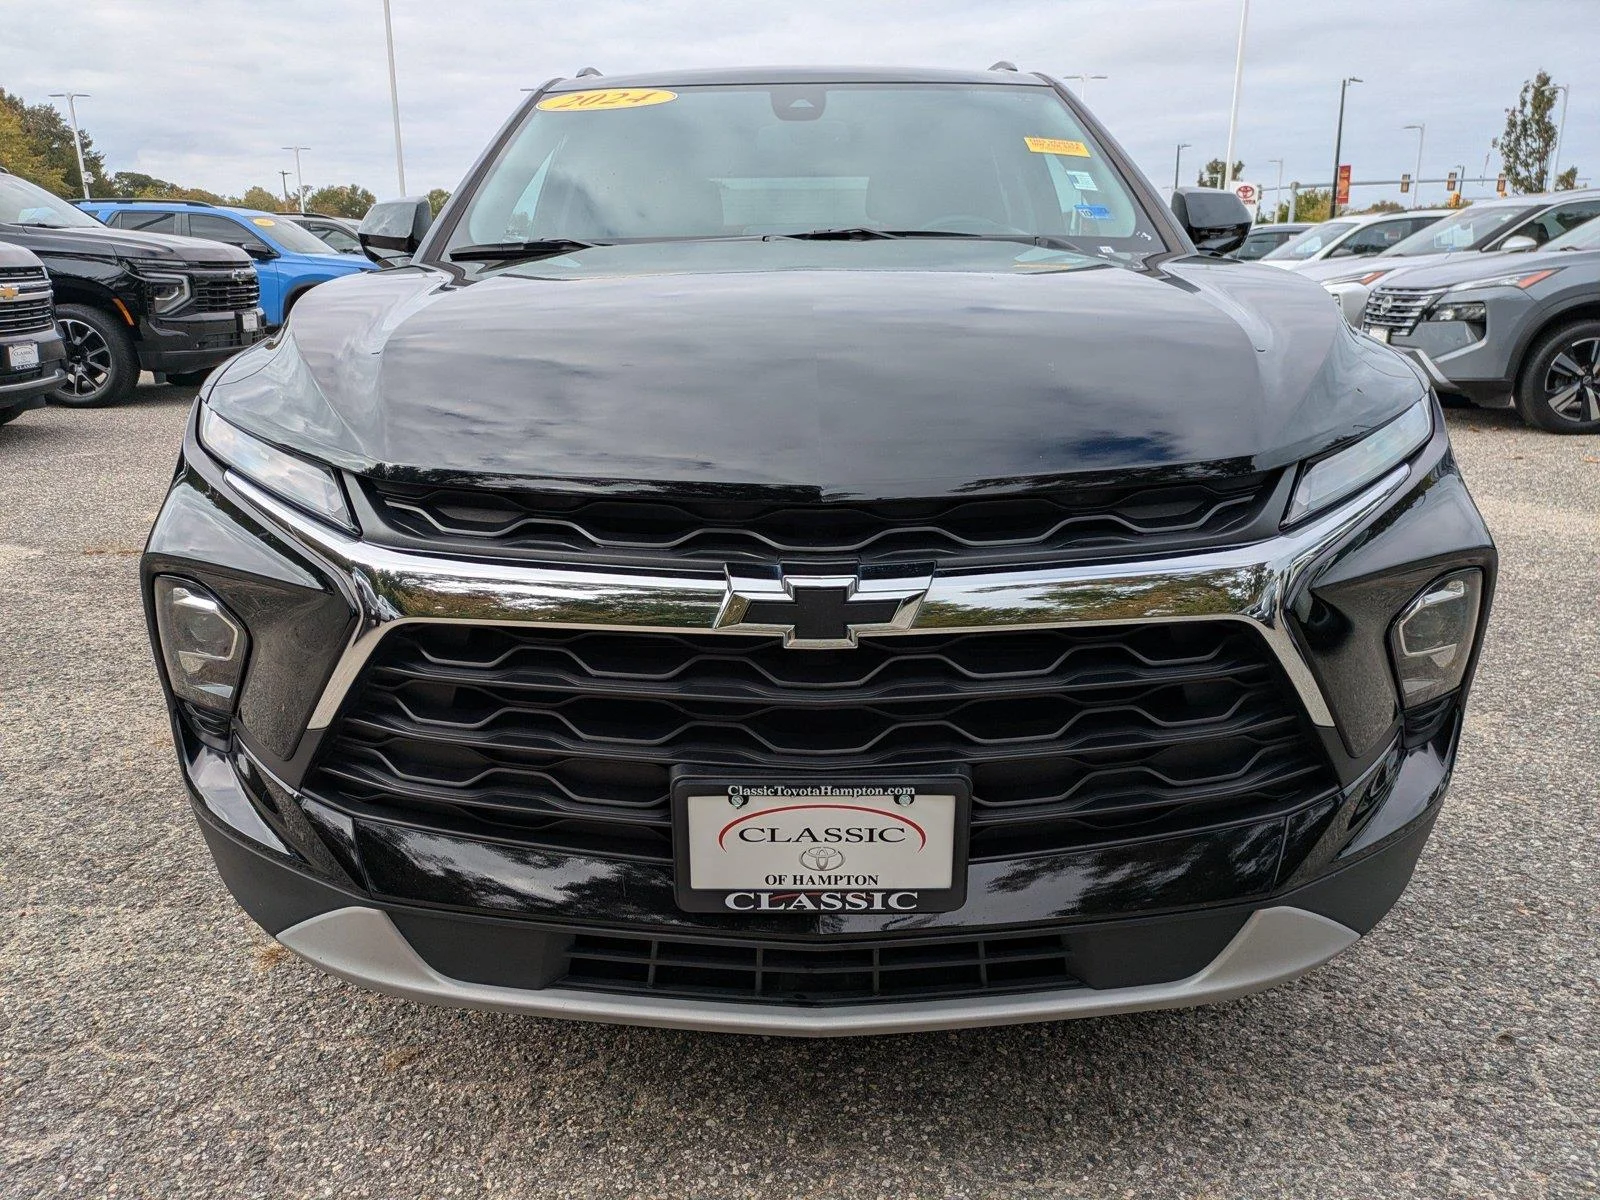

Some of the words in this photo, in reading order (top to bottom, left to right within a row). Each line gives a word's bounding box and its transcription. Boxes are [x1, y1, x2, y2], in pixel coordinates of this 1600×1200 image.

[553, 92, 656, 108] 2024
[728, 785, 916, 797] ClassicToyotaHampton.com
[739, 827, 906, 843] CLASSIC
[765, 875, 787, 886] OF
[793, 875, 880, 886] HAMPTON
[724, 892, 918, 910] CLASSIC
